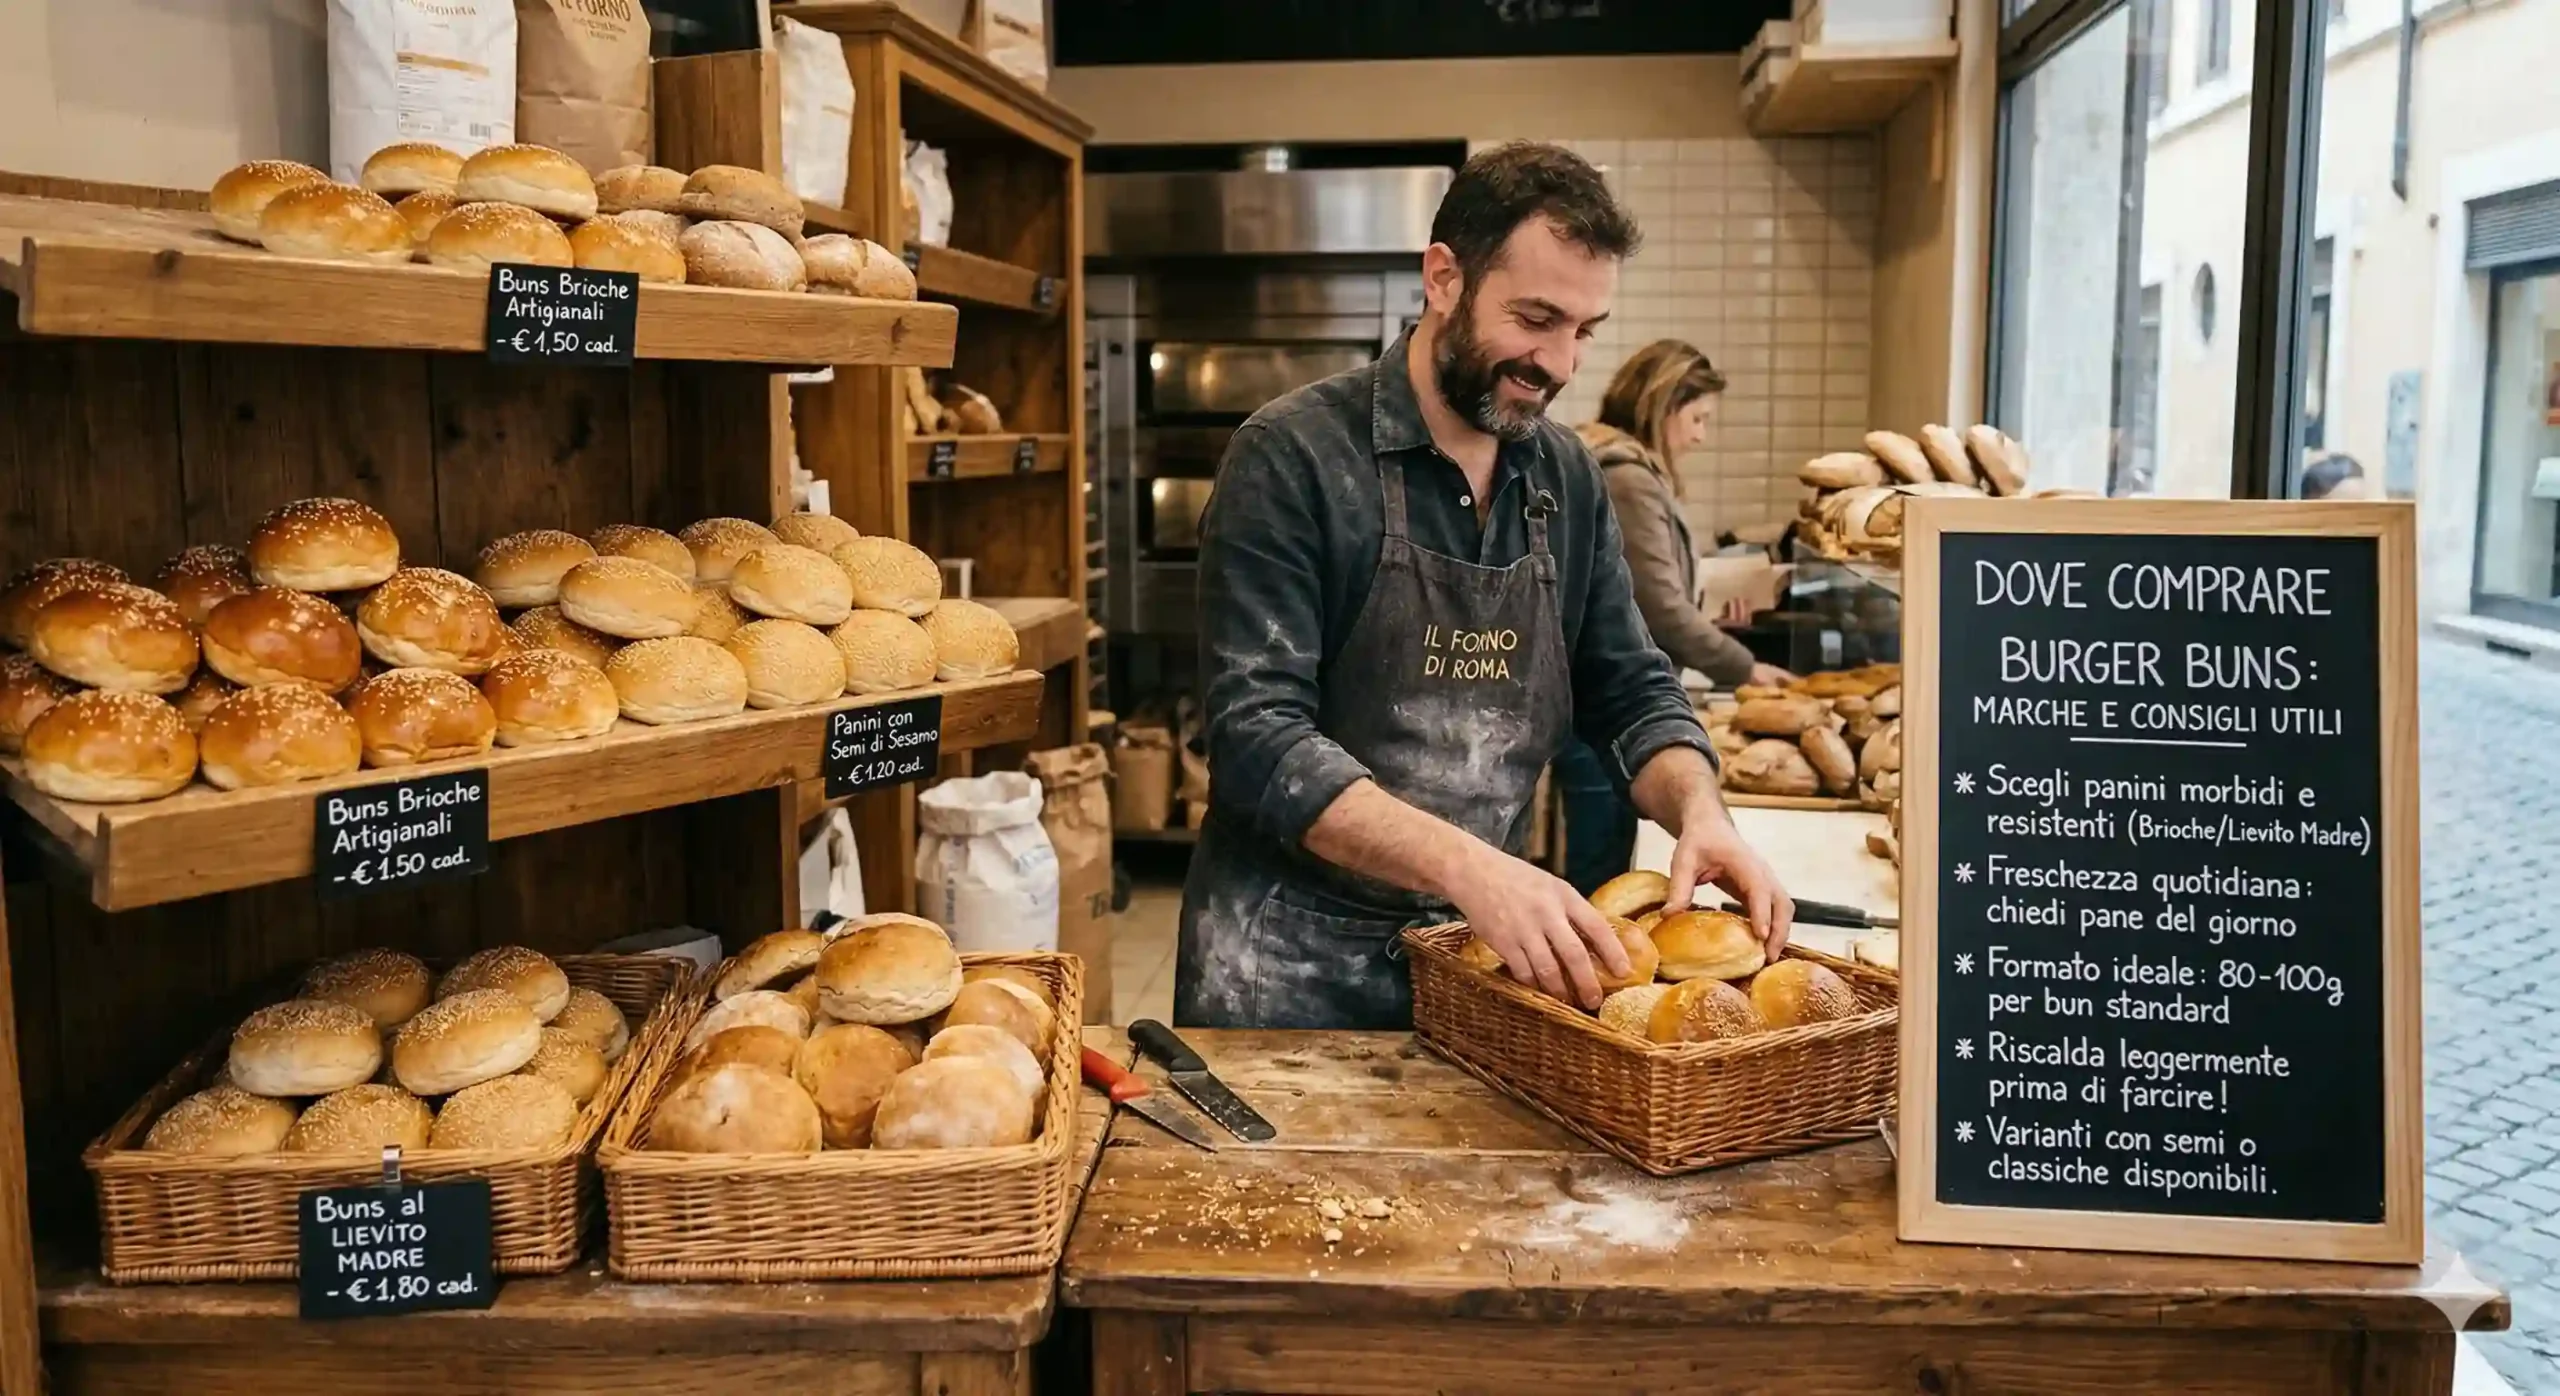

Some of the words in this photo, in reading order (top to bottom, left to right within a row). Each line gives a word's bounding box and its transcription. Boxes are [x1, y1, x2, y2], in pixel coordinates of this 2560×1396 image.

[499, 269, 549, 294] Buns
[560, 273, 629, 299] Brioche
[506, 296, 603, 327] Artigianali
[585, 335, 617, 352] cad.
[1975, 560, 2086, 607] DOVE
[2108, 563, 2331, 615] COMPRARE
[1424, 625, 1441, 647] IL
[1425, 656, 1446, 676] DI
[1453, 659, 1509, 679] ROMA
[2001, 637, 2164, 686] BURGER
[2187, 643, 2317, 690] BUNS:
[835, 711, 881, 735] Panini
[888, 713, 912, 727] con
[1974, 696, 2087, 726] MARCHE
[2102, 702, 2118, 727] E
[2131, 703, 2256, 731] CONSIGLI
[2272, 708, 2341, 734] UTILI
[831, 738, 865, 759] Semi
[870, 734, 883, 752] di
[888, 729, 937, 749] Sesamo
[898, 756, 923, 774] cad.
[329, 799, 388, 825] Buns
[399, 782, 480, 812] Brioche
[1987, 764, 2069, 806] Scegli
[2085, 775, 2165, 808] panini
[2181, 775, 2283, 805] morbidi
[2299, 788, 2315, 807] e
[332, 812, 452, 854] Artigianali
[1988, 808, 2114, 838] resistenti
[2128, 809, 2294, 846] (Brioche/Lievito
[2301, 817, 2370, 855] Madre)
[1989, 855, 2137, 891] Freschezza
[2153, 865, 2311, 902] quotidiana:
[1987, 896, 2065, 925] chiedi
[2081, 909, 2143, 936] pane
[2157, 904, 2194, 932] del
[2209, 909, 2296, 944] giorno
[1989, 946, 2100, 981] Formato
[2114, 954, 2205, 985] ideale:
[2216, 960, 2344, 1009] 80-100g
[1989, 994, 2032, 1021] per
[2045, 987, 2092, 1016] bun
[2106, 992, 2229, 1024] standard
[1989, 1031, 2104, 1066] Riscalda
[2121, 1038, 2289, 1082] leggermente
[1990, 1073, 2067, 1107] prima
[2081, 1076, 2105, 1103] di
[2120, 1075, 2226, 1113] farcire!
[1986, 1115, 2090, 1148] Varianti
[2106, 1131, 2150, 1150] con
[2163, 1130, 2224, 1154] semi
[2240, 1138, 2256, 1156] o
[1989, 1153, 2108, 1184] classiche
[2124, 1158, 2277, 1197] disponibili.
[317, 1196, 385, 1222] Buns
[401, 1190, 423, 1215] al
[339, 1248, 424, 1272] MADRE
[437, 1273, 477, 1294] cad.
